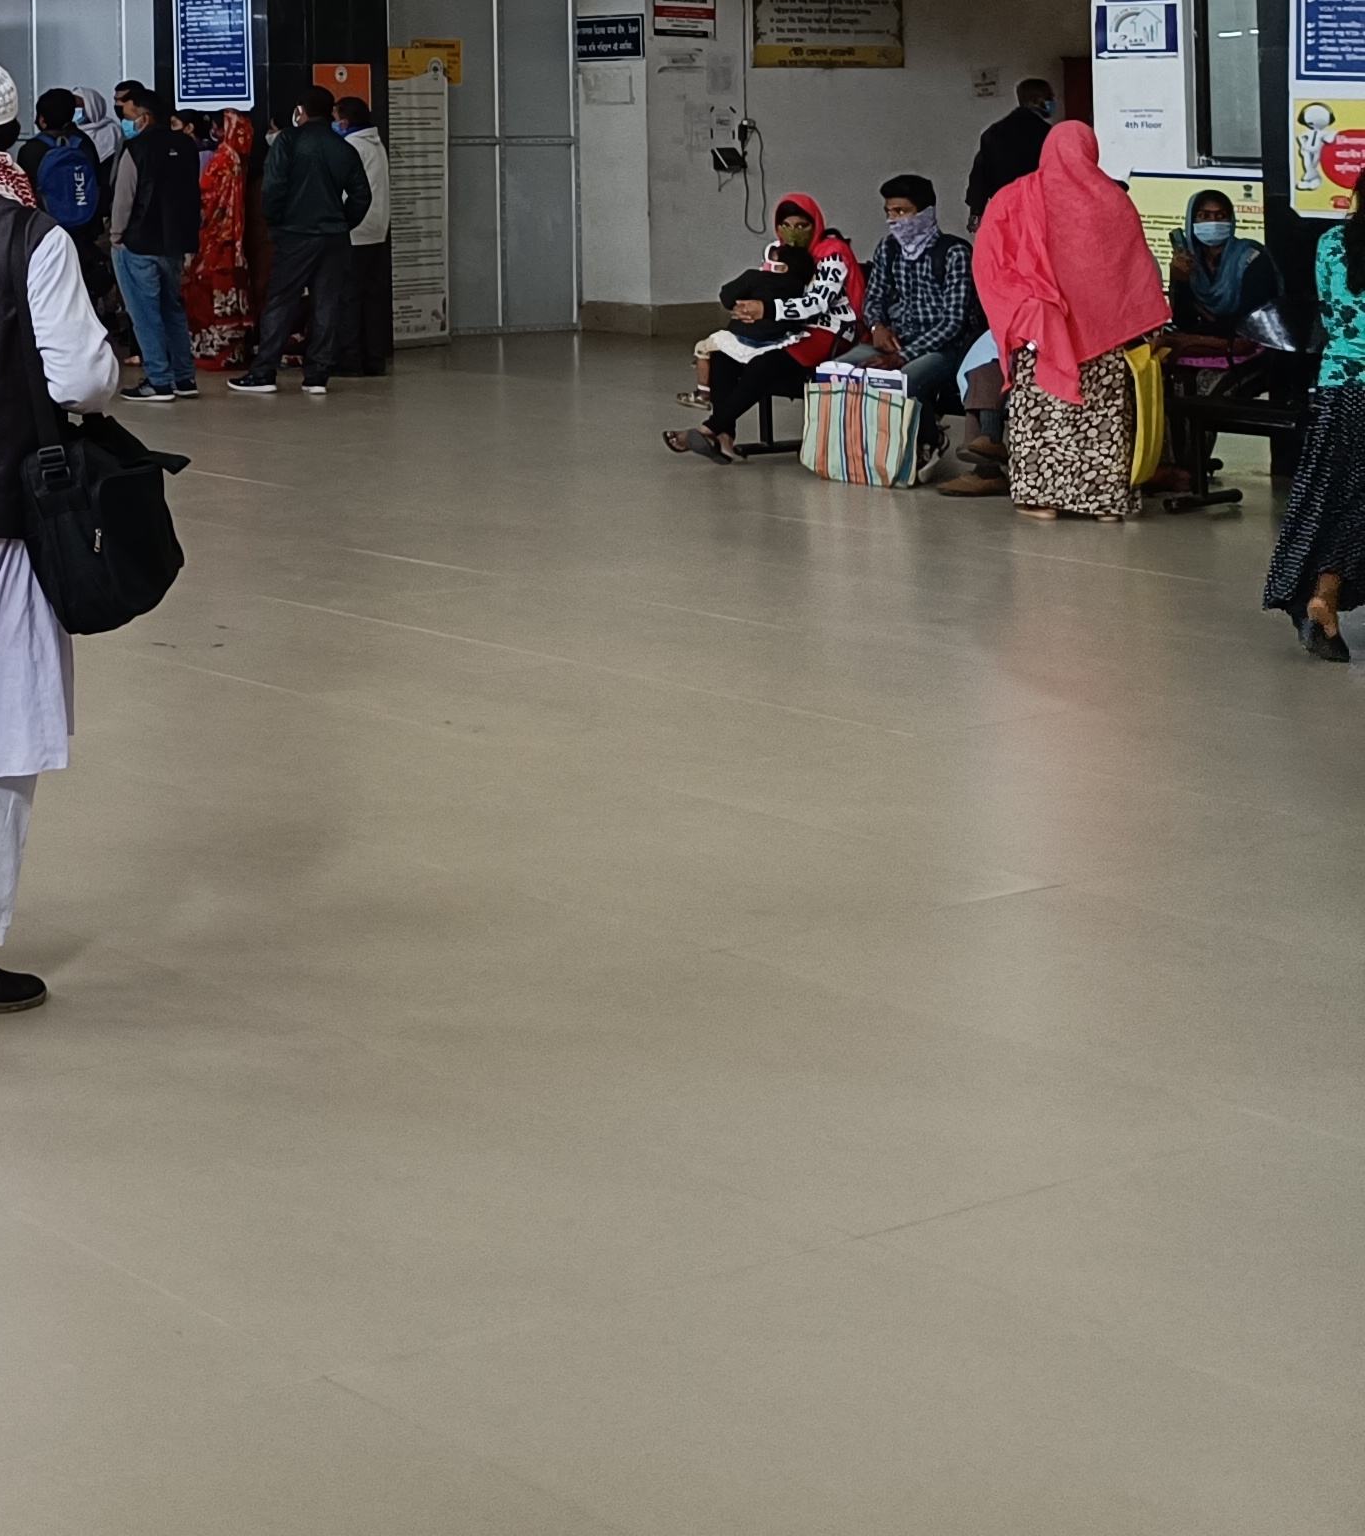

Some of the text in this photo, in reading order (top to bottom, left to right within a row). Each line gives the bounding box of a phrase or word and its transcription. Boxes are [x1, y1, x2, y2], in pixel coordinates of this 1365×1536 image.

[1124, 121, 1162, 129] 4th Floor
[74, 172, 88, 206] NIKE
